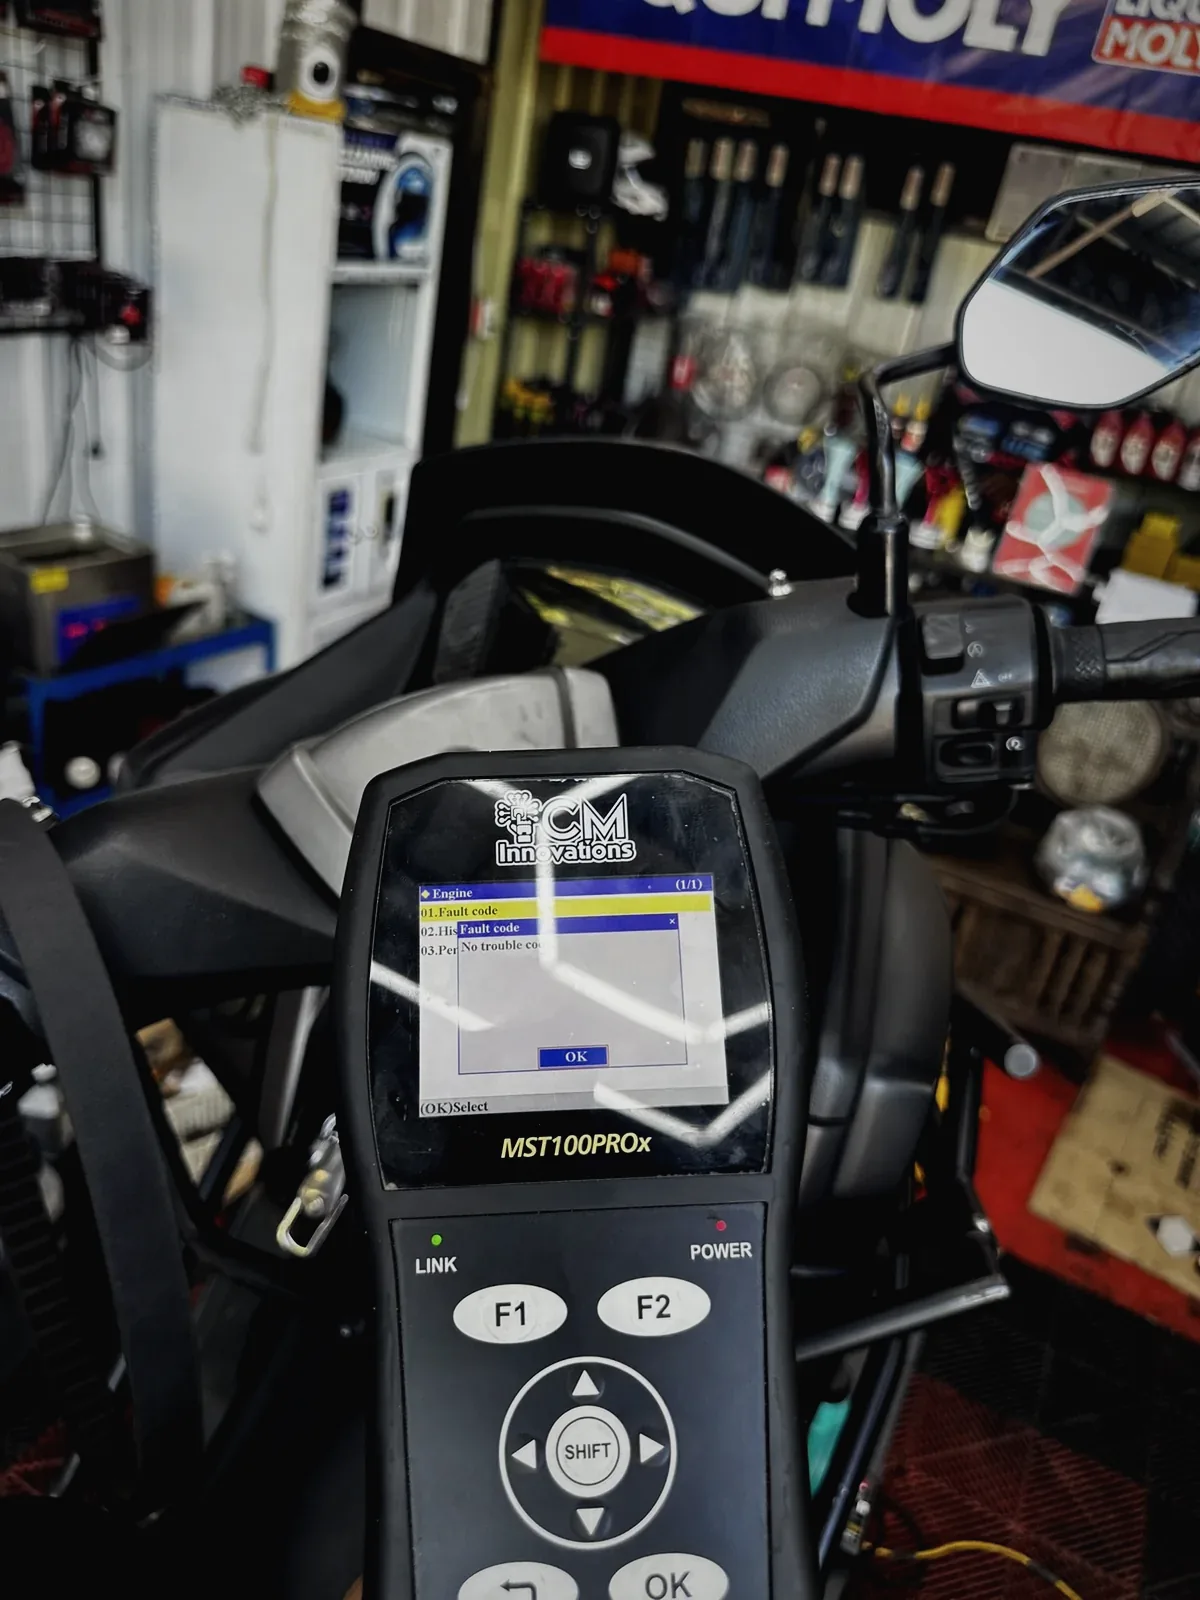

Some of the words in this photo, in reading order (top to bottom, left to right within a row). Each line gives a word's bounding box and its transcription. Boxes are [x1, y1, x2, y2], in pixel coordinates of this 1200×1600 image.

[1101, 19, 1200, 67] MOL
[497, 841, 635, 864] Innovations
[675, 878, 703, 891] (1/1)
[432, 888, 473, 900] Engine
[420, 907, 469, 918] 01.Fault
[471, 905, 499, 916] code
[460, 924, 490, 934] Fault
[493, 923, 520, 933] code
[461, 941, 478, 952] No
[481, 940, 522, 951] trouble
[565, 1051, 588, 1062] OK
[420, 1101, 489, 1116] (OK)Select
[500, 1132, 652, 1159] MST100PROx
[690, 1242, 752, 1260] POWER
[415, 1257, 458, 1274] LINK
[495, 1301, 526, 1327] F1
[637, 1294, 671, 1320] F2
[565, 1442, 611, 1460] SHIFT
[645, 1571, 693, 1600] OK
